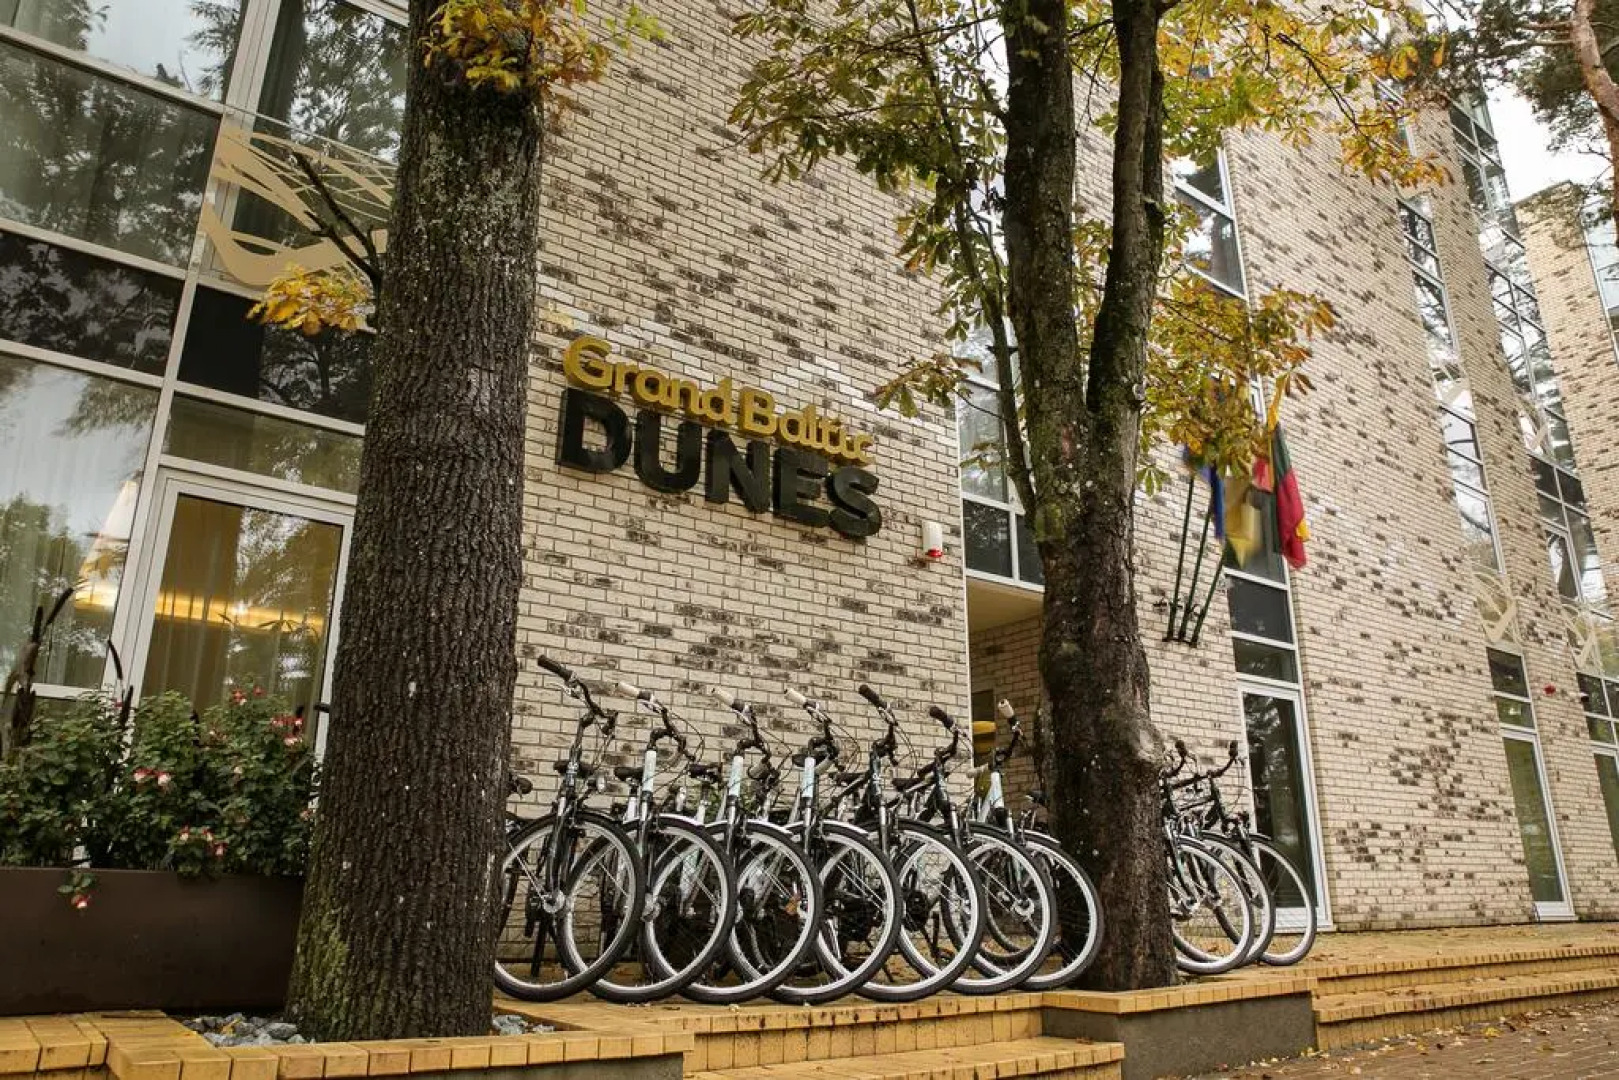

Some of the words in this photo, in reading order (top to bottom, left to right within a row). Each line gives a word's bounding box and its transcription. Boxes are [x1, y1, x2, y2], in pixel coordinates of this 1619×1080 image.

[557, 387, 883, 538] DUNES
[563, 336, 734, 427] Grand
[738, 387, 875, 465] Baltic
